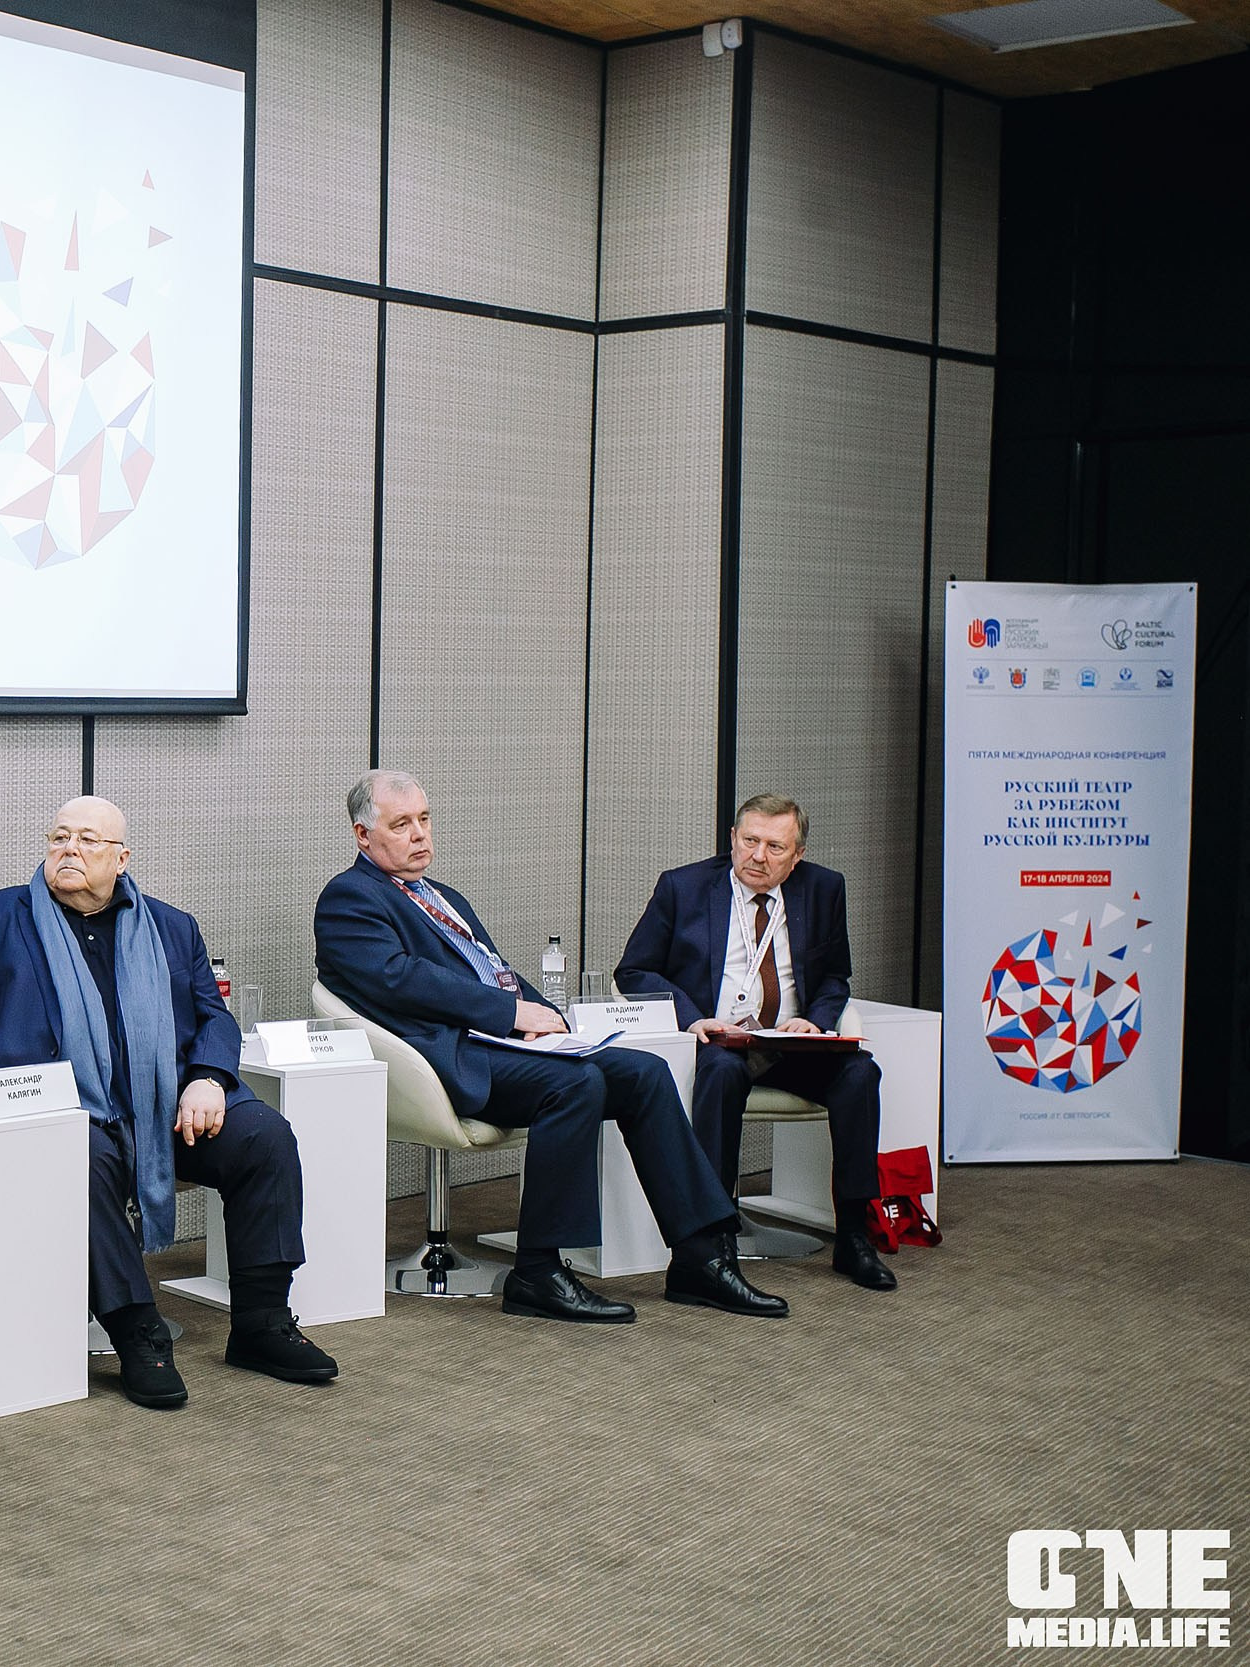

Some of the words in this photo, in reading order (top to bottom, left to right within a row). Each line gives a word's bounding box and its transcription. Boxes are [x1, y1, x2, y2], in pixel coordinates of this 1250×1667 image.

[1135, 621, 1162, 629] BALTIC
[1135, 630, 1176, 639] CULTURAL
[1135, 640, 1164, 648] FORUM
[968, 750, 1000, 759] ПЯТАЯ
[1002, 751, 1091, 760] МЕЖДУНАРОДНАЯ
[1093, 751, 1167, 761] КОНФЕРЕНЦИЯ
[1004, 778, 1079, 793] РУССКИЙ
[1084, 781, 1133, 793] ТЕАТР
[1014, 799, 1033, 811] ЗА
[1039, 799, 1120, 811] РУБЕЖОМ
[1007, 817, 1040, 829] КАК
[1045, 817, 1129, 829] ИНСТИТУТ
[983, 832, 1057, 847] РУССКОЙ
[1063, 834, 1150, 847] КУЛЬТУРЫ
[1023, 874, 1046, 883] 17-18
[1049, 874, 1085, 884] АПРЕЛЯ
[1086, 874, 1109, 884] 2024
[605, 1006, 645, 1014] ВЛАДИМИР
[0, 1074, 43, 1088] АЛЕКСАНДР
[7, 1088, 42, 1100] КАЛЯГИН
